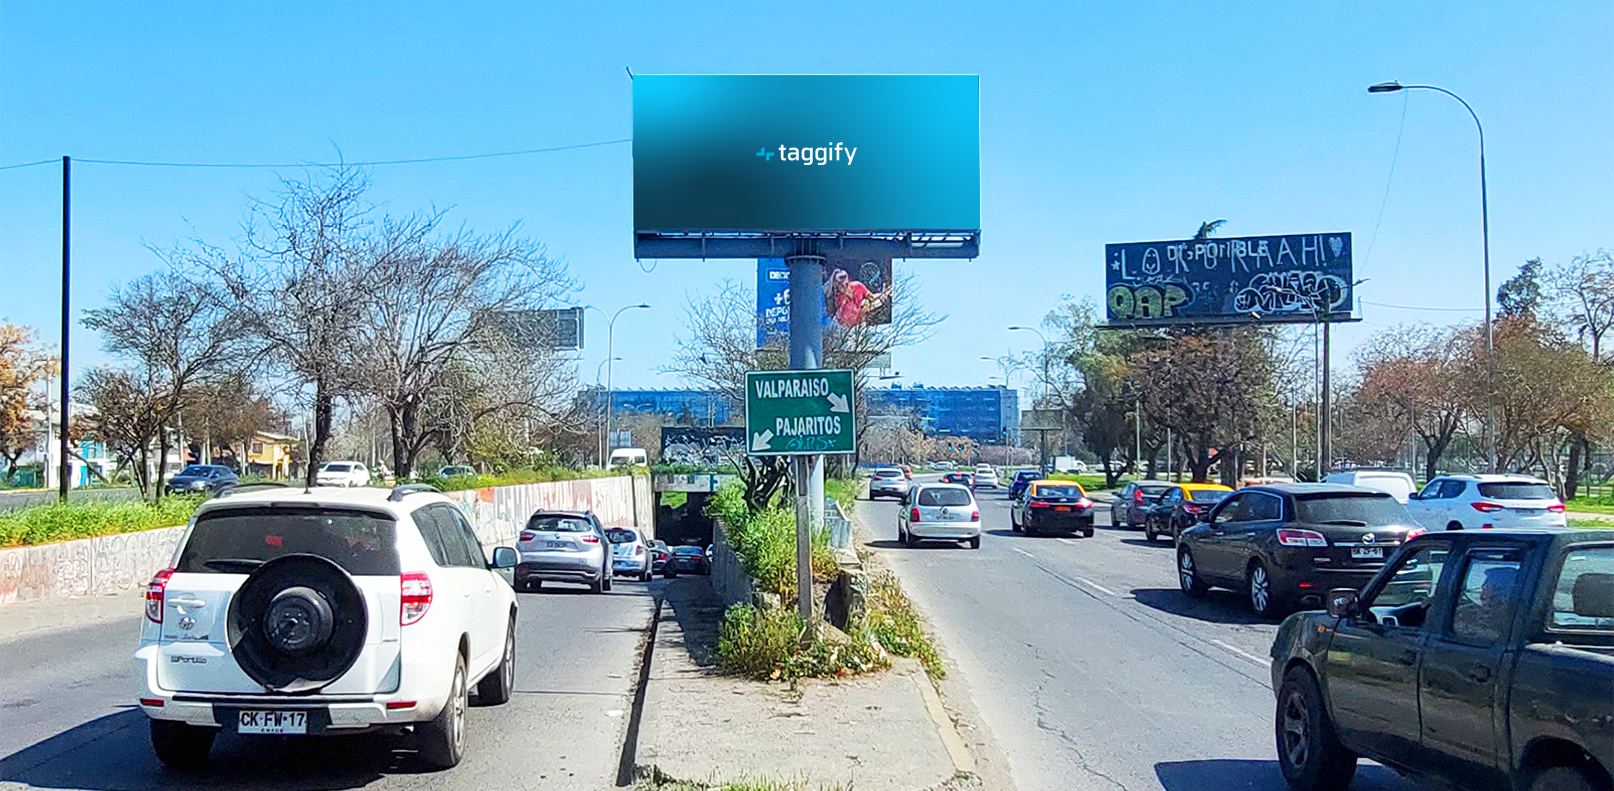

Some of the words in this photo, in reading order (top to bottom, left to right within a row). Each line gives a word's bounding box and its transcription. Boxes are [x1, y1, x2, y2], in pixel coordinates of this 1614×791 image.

[778, 142, 857, 165] taggify
[755, 378, 828, 398] VALPARAISO
[776, 415, 841, 436] PAJARITOS
